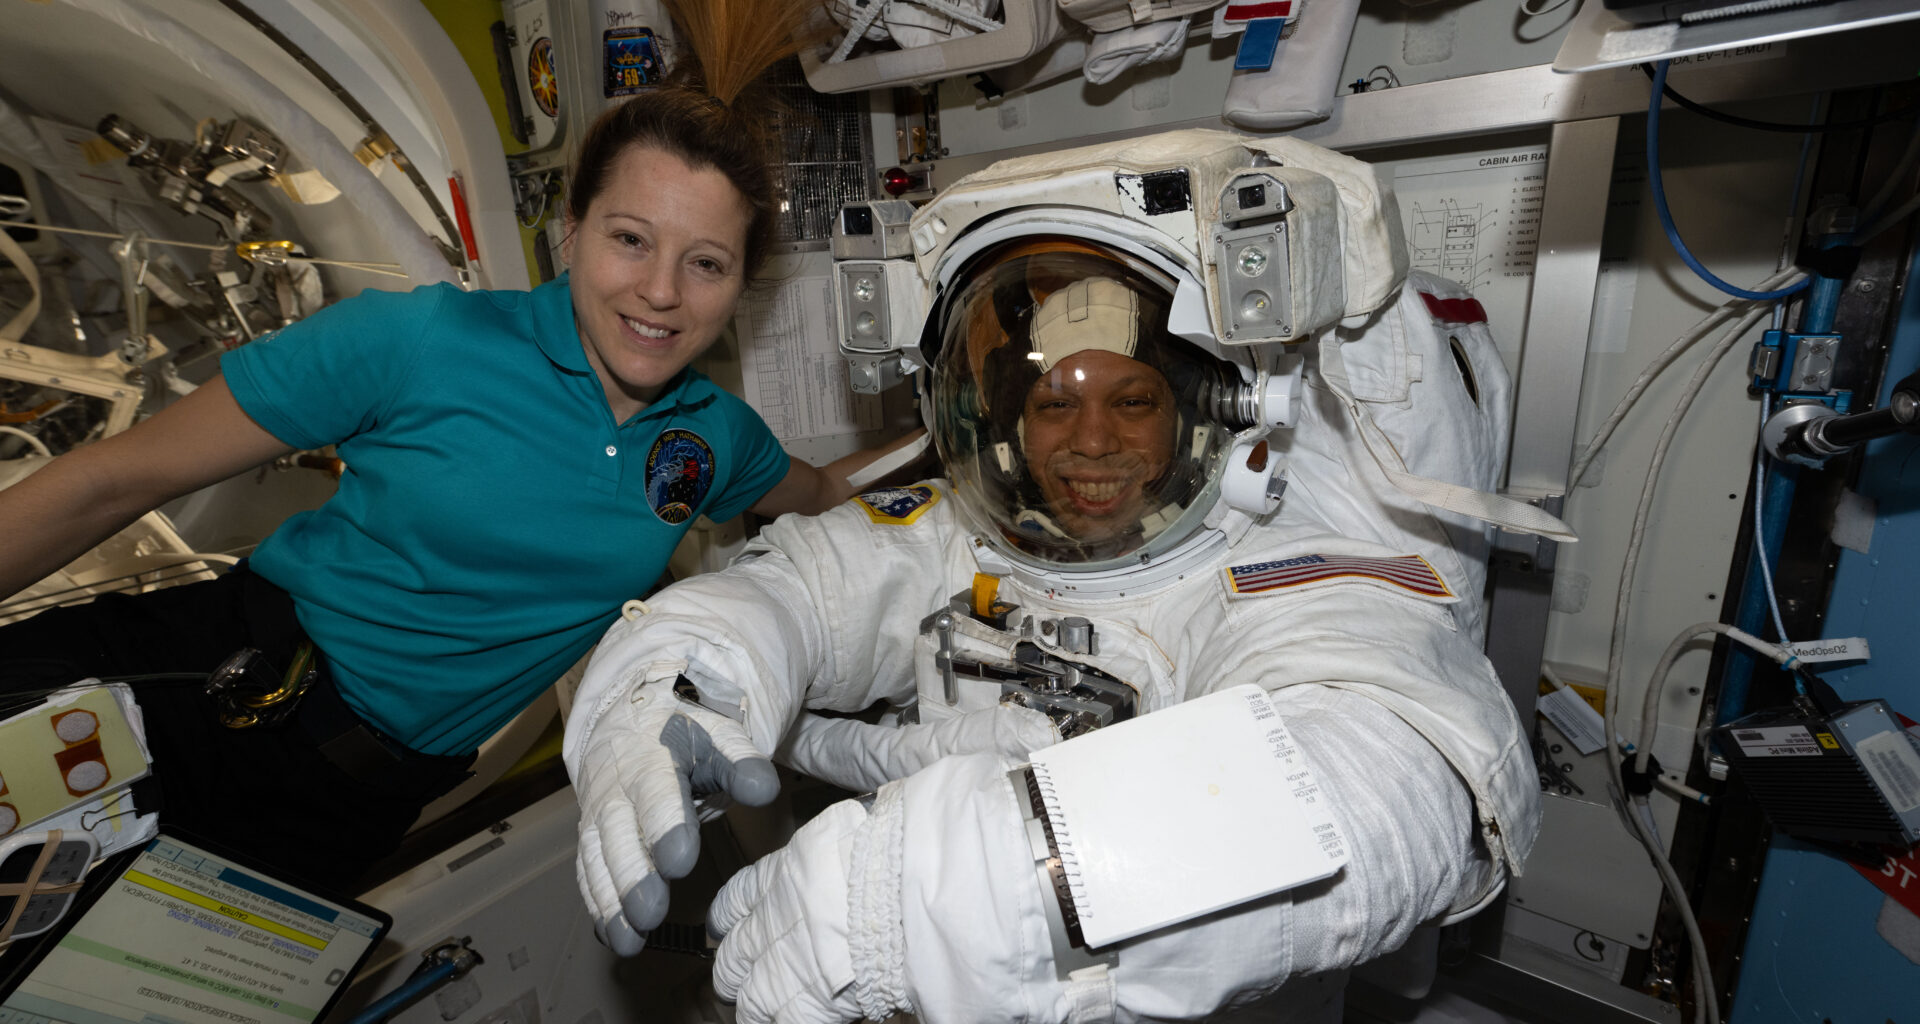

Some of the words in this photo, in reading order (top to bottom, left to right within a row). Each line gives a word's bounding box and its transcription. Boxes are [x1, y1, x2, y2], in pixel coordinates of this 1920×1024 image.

[624, 68, 640, 87] 59
[1479, 156, 1509, 167] CABIN
[1511, 154, 1528, 164] AIR
[1792, 645, 1848, 657] MedOps02
[1768, 747, 1780, 755] PC
[1779, 747, 1796, 755] Mini
[1796, 746, 1819, 755] Adlink
[1286, 771, 1309, 782] HATCH
[1294, 787, 1318, 798] HATCH
[1322, 839, 1342, 851] LIGHT
[160, 859, 179, 870] SCU
[160, 871, 183, 882] should
[176, 866, 209, 881] integrated
[207, 877, 221, 886] The
[235, 888, 252, 898] SCU
[217, 905, 248, 920] CAUTION
[122, 955, 160, 970] conference
[278, 970, 297, 981] When
[213, 982, 231, 992] MCC
[135, 987, 172, 1002] MINUTES)
